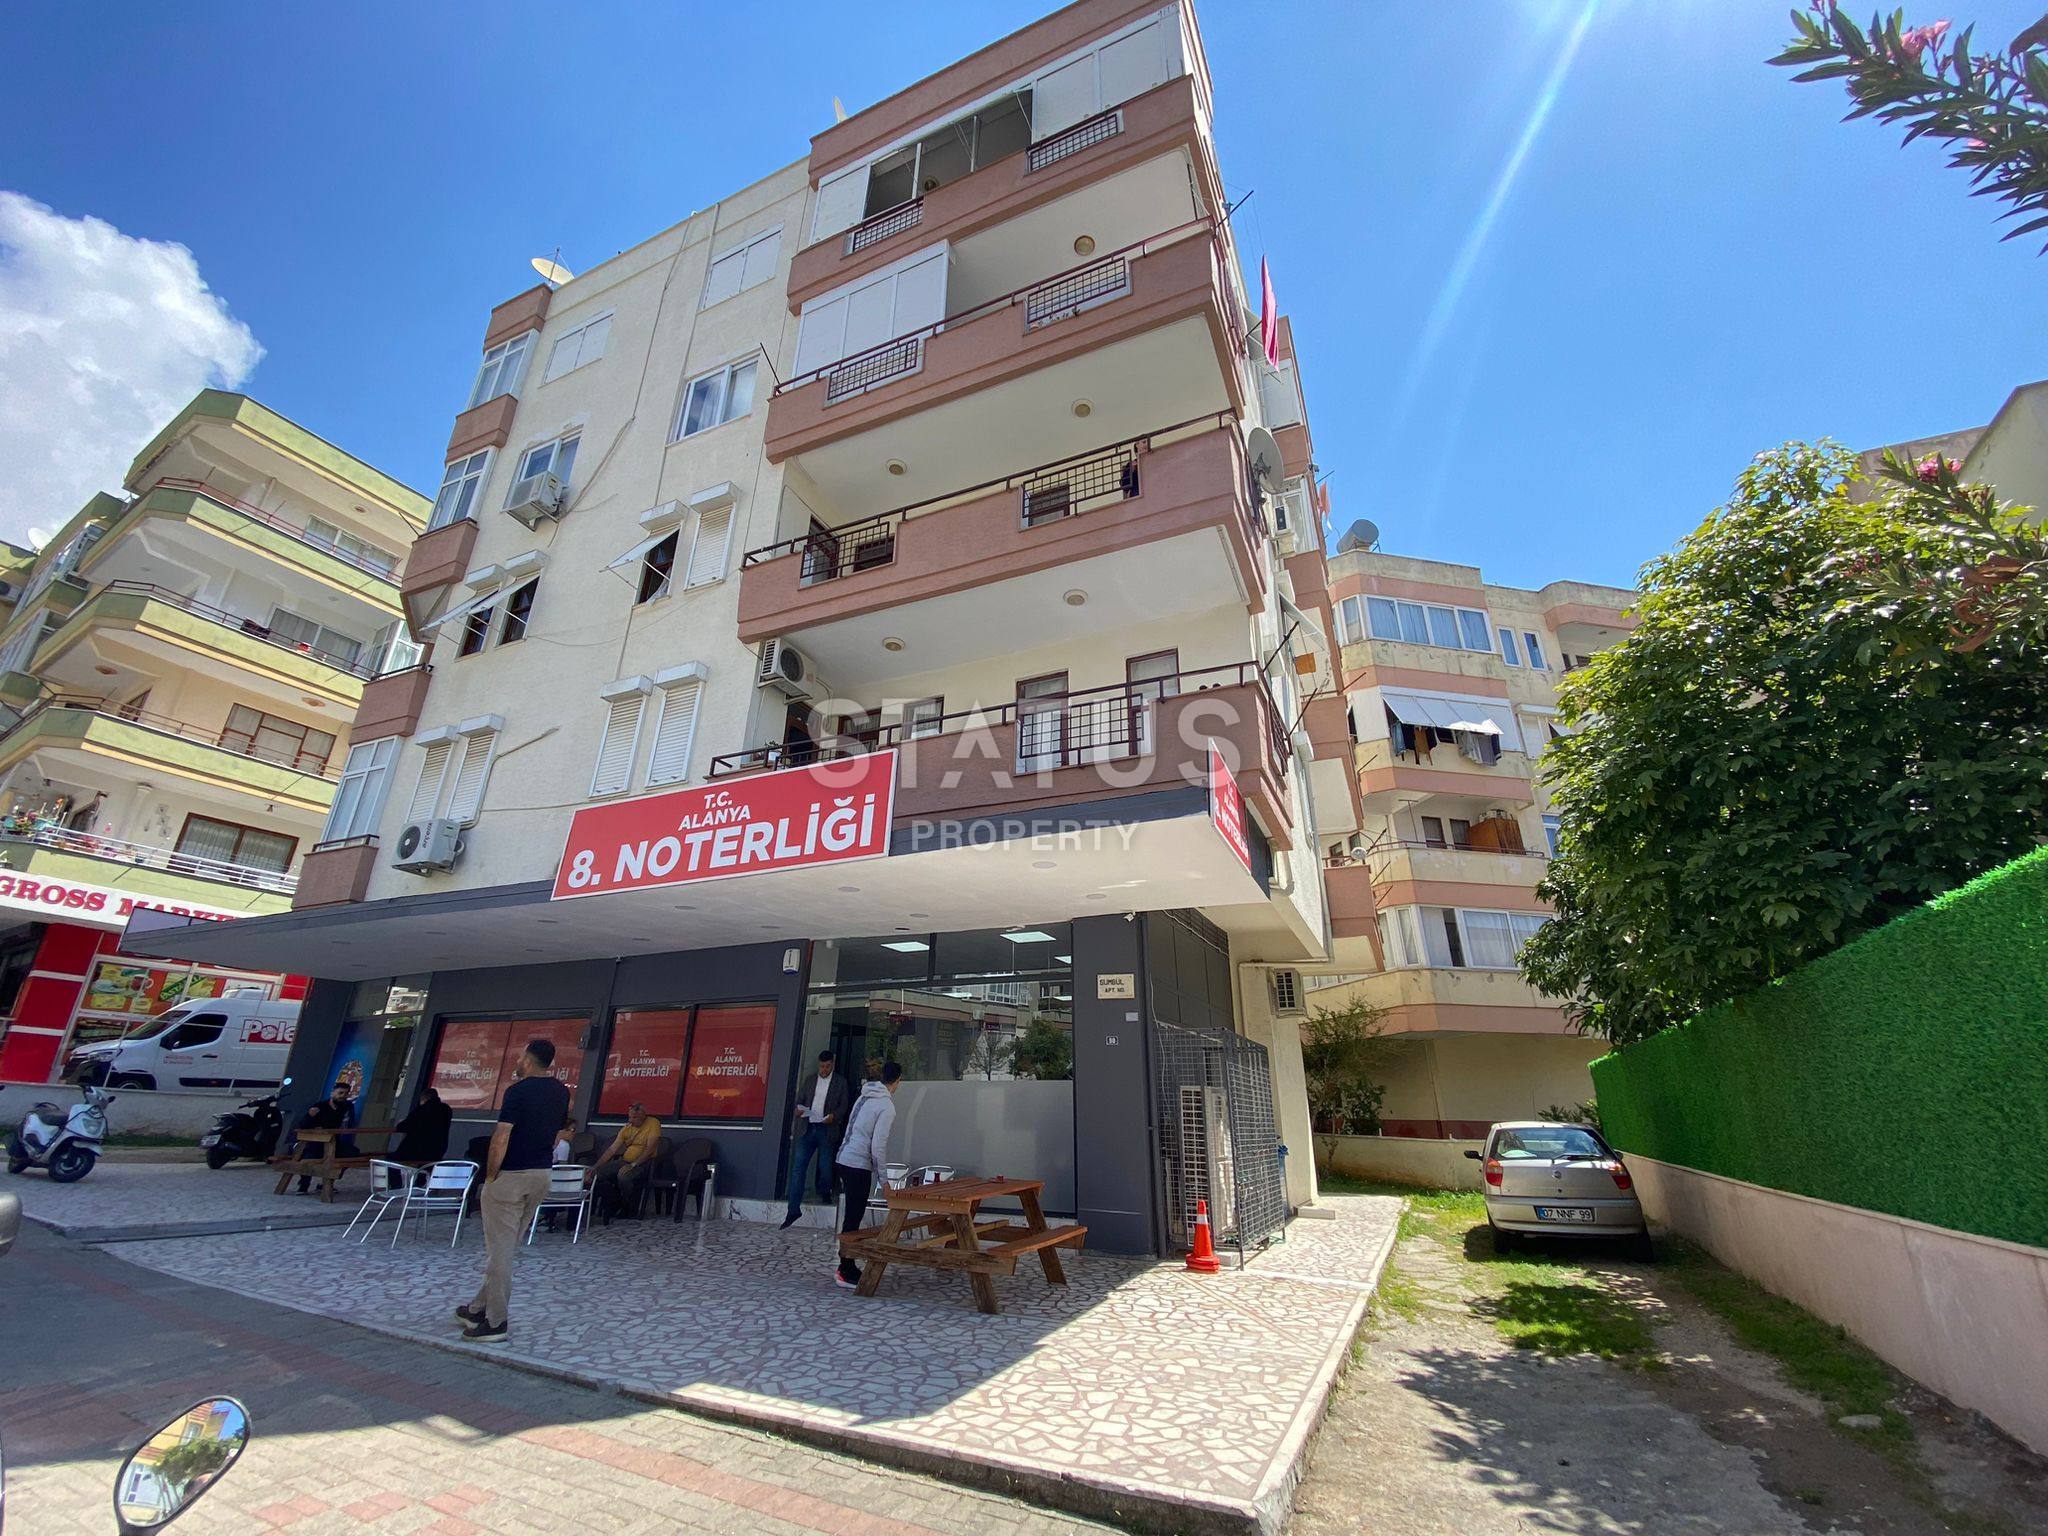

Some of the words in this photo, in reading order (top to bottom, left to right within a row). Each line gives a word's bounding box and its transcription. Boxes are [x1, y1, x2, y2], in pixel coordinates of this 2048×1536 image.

[704, 791, 732, 808] T.C.
[678, 804, 751, 831] ALANYA
[567, 850, 601, 888] 8.
[613, 793, 876, 882] NOTERLİĞİ
[0, 875, 106, 911] GROSS
[623, 1065, 669, 1077] NOTERLİĞİ
[706, 1064, 758, 1076] NOTERLİĞİ
